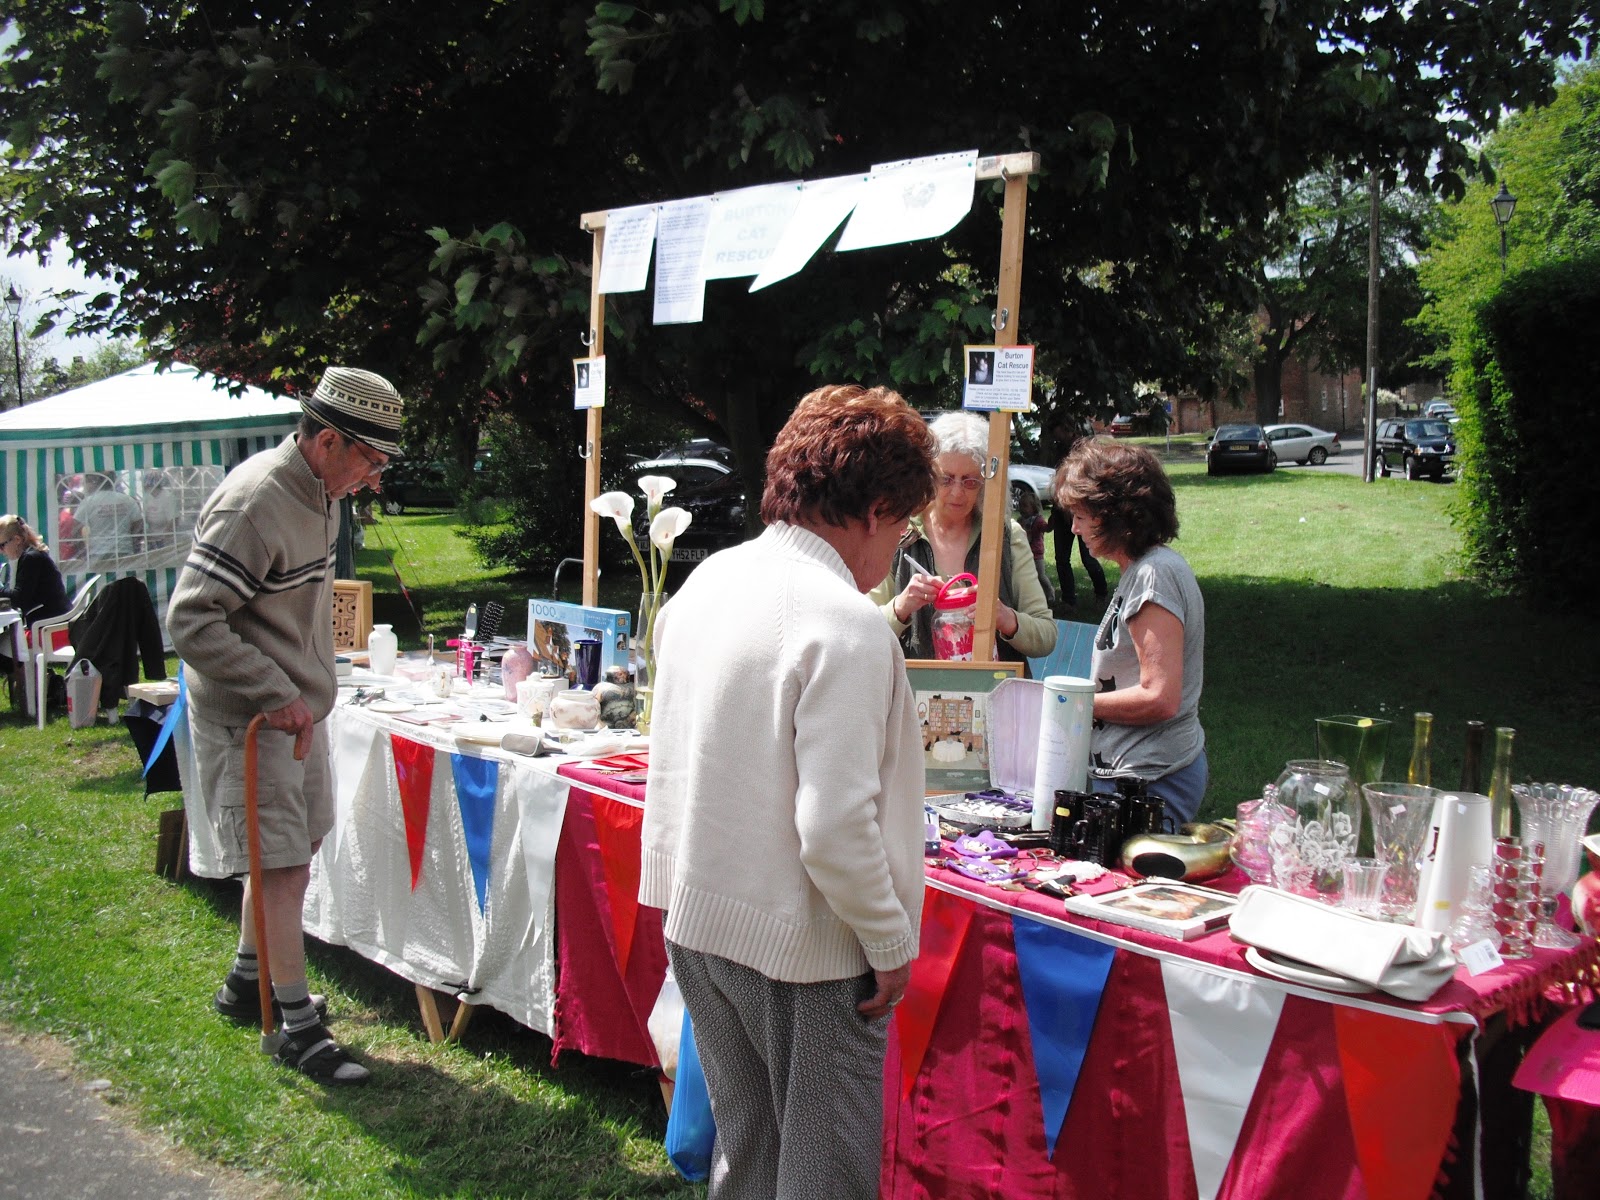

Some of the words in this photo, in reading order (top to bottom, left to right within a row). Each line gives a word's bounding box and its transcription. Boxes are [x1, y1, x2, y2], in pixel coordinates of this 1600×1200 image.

[737, 226, 768, 240] CAT
[691, 550, 705, 560] FLP
[531, 603, 557, 618] 1000
